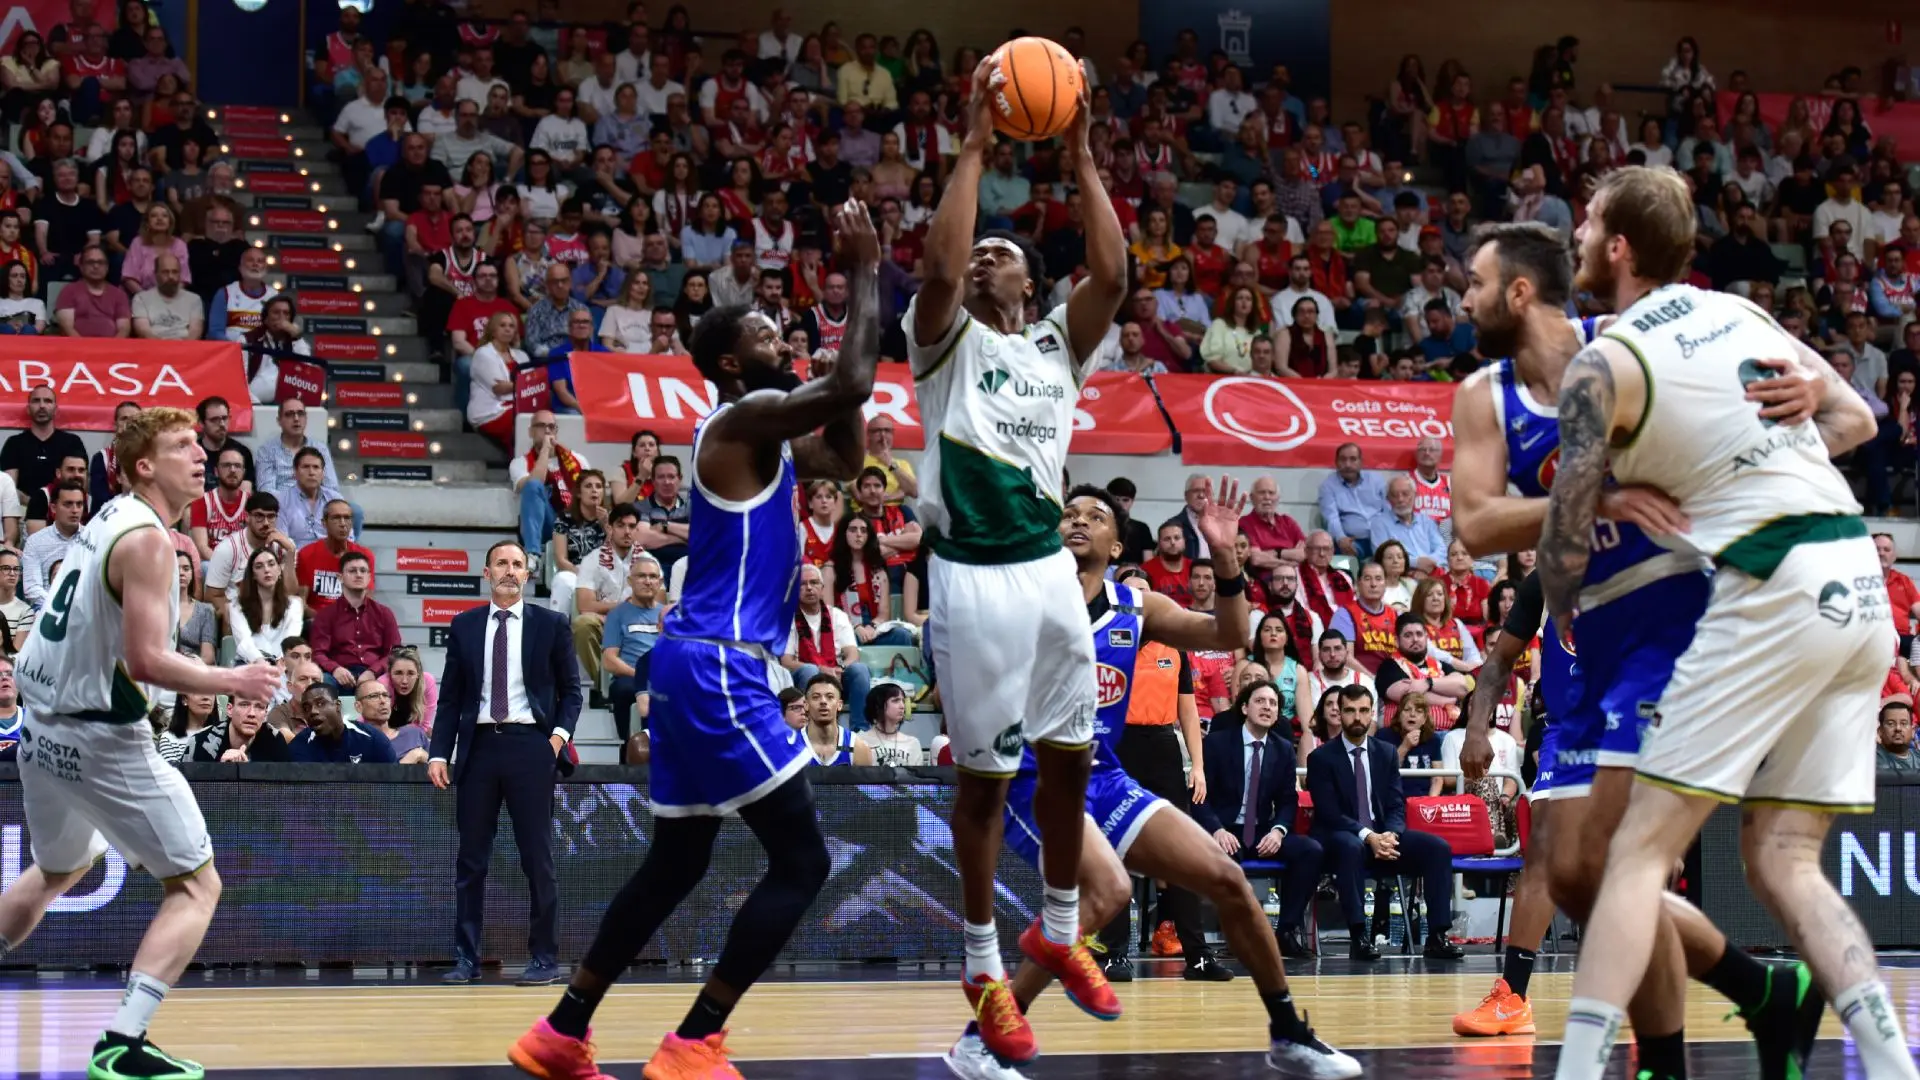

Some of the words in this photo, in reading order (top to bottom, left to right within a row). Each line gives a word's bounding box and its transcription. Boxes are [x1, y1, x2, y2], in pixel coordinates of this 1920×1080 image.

[1015, 380, 1064, 403] Unicaja
[1331, 400, 1382, 413] Costa
[313, 575, 344, 594] FINA
[40, 569, 81, 642] 9
[38, 735, 81, 760] COSTA
[37, 749, 54, 766] DEL
[56, 759, 82, 772] SOL
[1101, 788, 1144, 835] NVERSUS
[1441, 804, 1471, 813] UCAM
